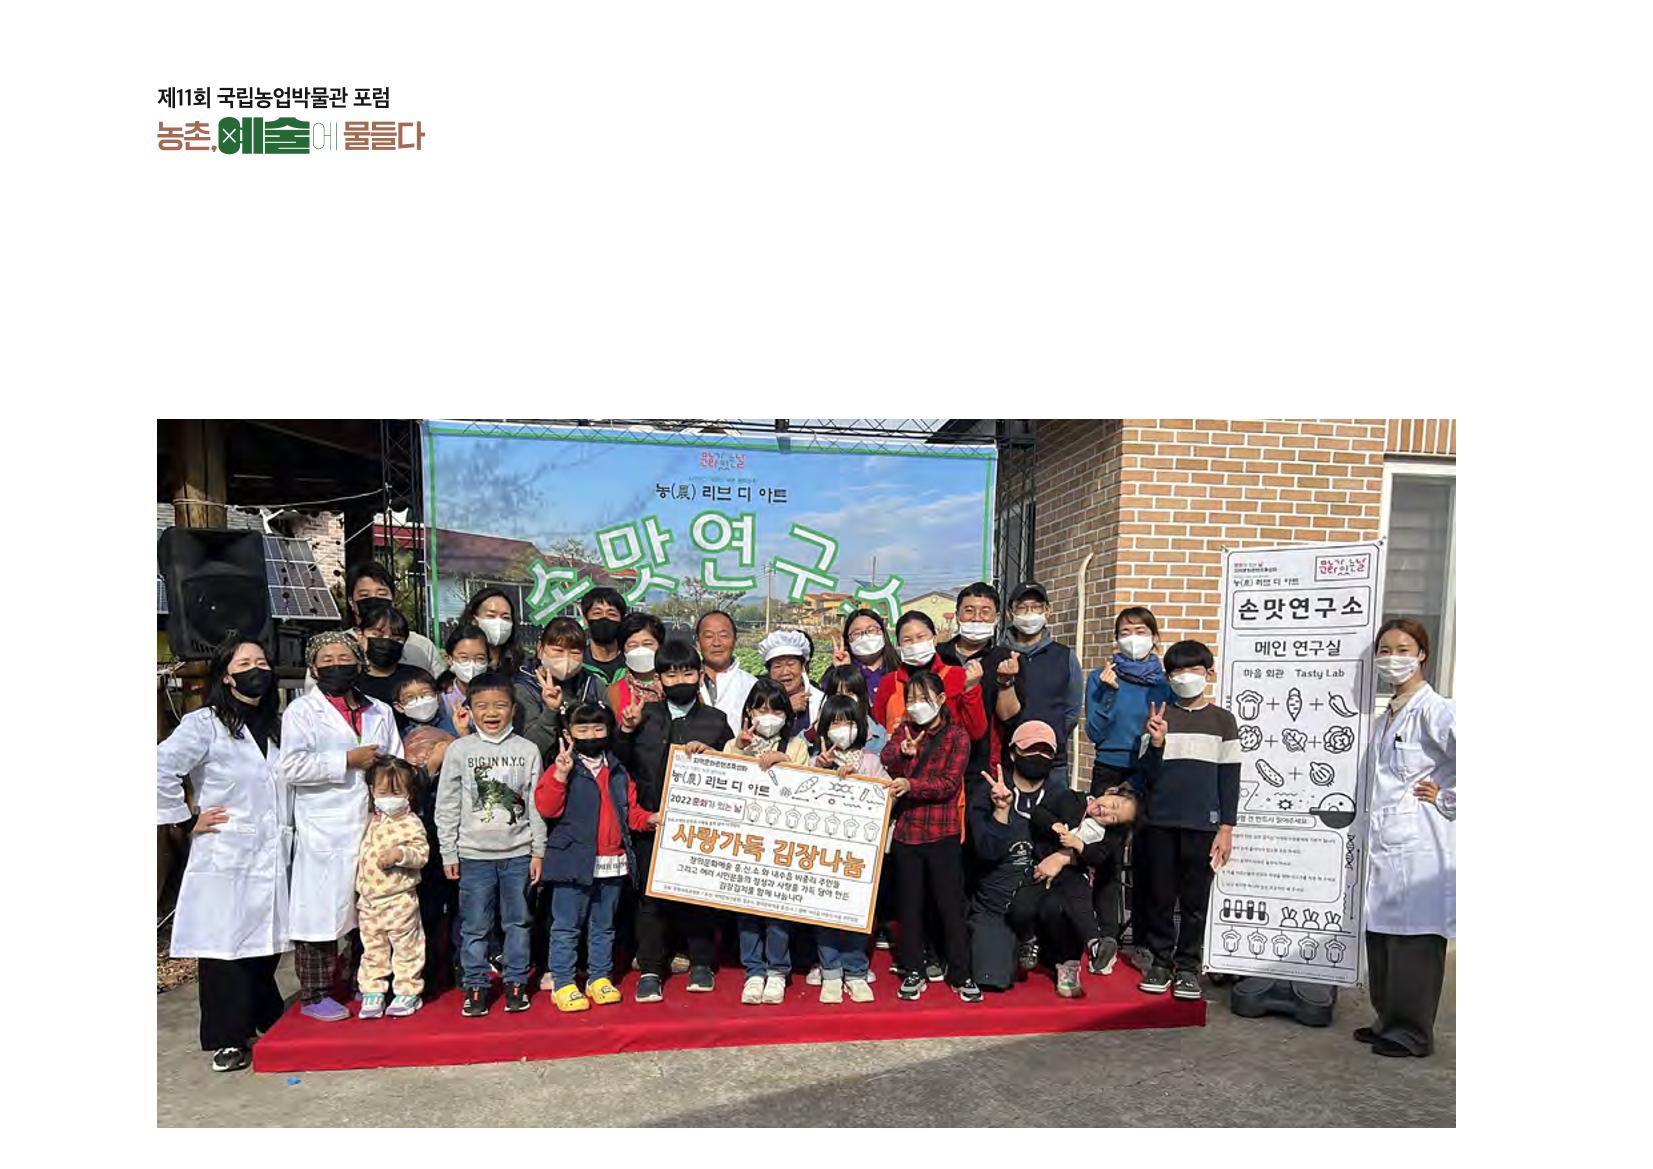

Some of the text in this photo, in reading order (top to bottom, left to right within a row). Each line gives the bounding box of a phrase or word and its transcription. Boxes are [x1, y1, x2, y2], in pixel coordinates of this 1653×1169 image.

[157, 87, 390, 109] 제11회 국립농업박물관 포럼
[157, 120, 217, 152] 농촌,
[344, 121, 425, 150] 물들다
[702, 485, 732, 501] 리브
[738, 486, 751, 502] 디
[759, 488, 787, 503] 아트
[1238, 596, 1363, 621] 손맛연구소
[1254, 639, 1341, 657] 메인 연구실
[1295, 668, 1345, 680] Tasty Lab
[488, 756, 498, 767] IN
[705, 775, 728, 790] 리브
[731, 780, 743, 793] 디
[748, 784, 770, 797] 아트
[670, 794, 691, 805] 2022
[672, 824, 866, 879] 사랑가득 김장나눔
